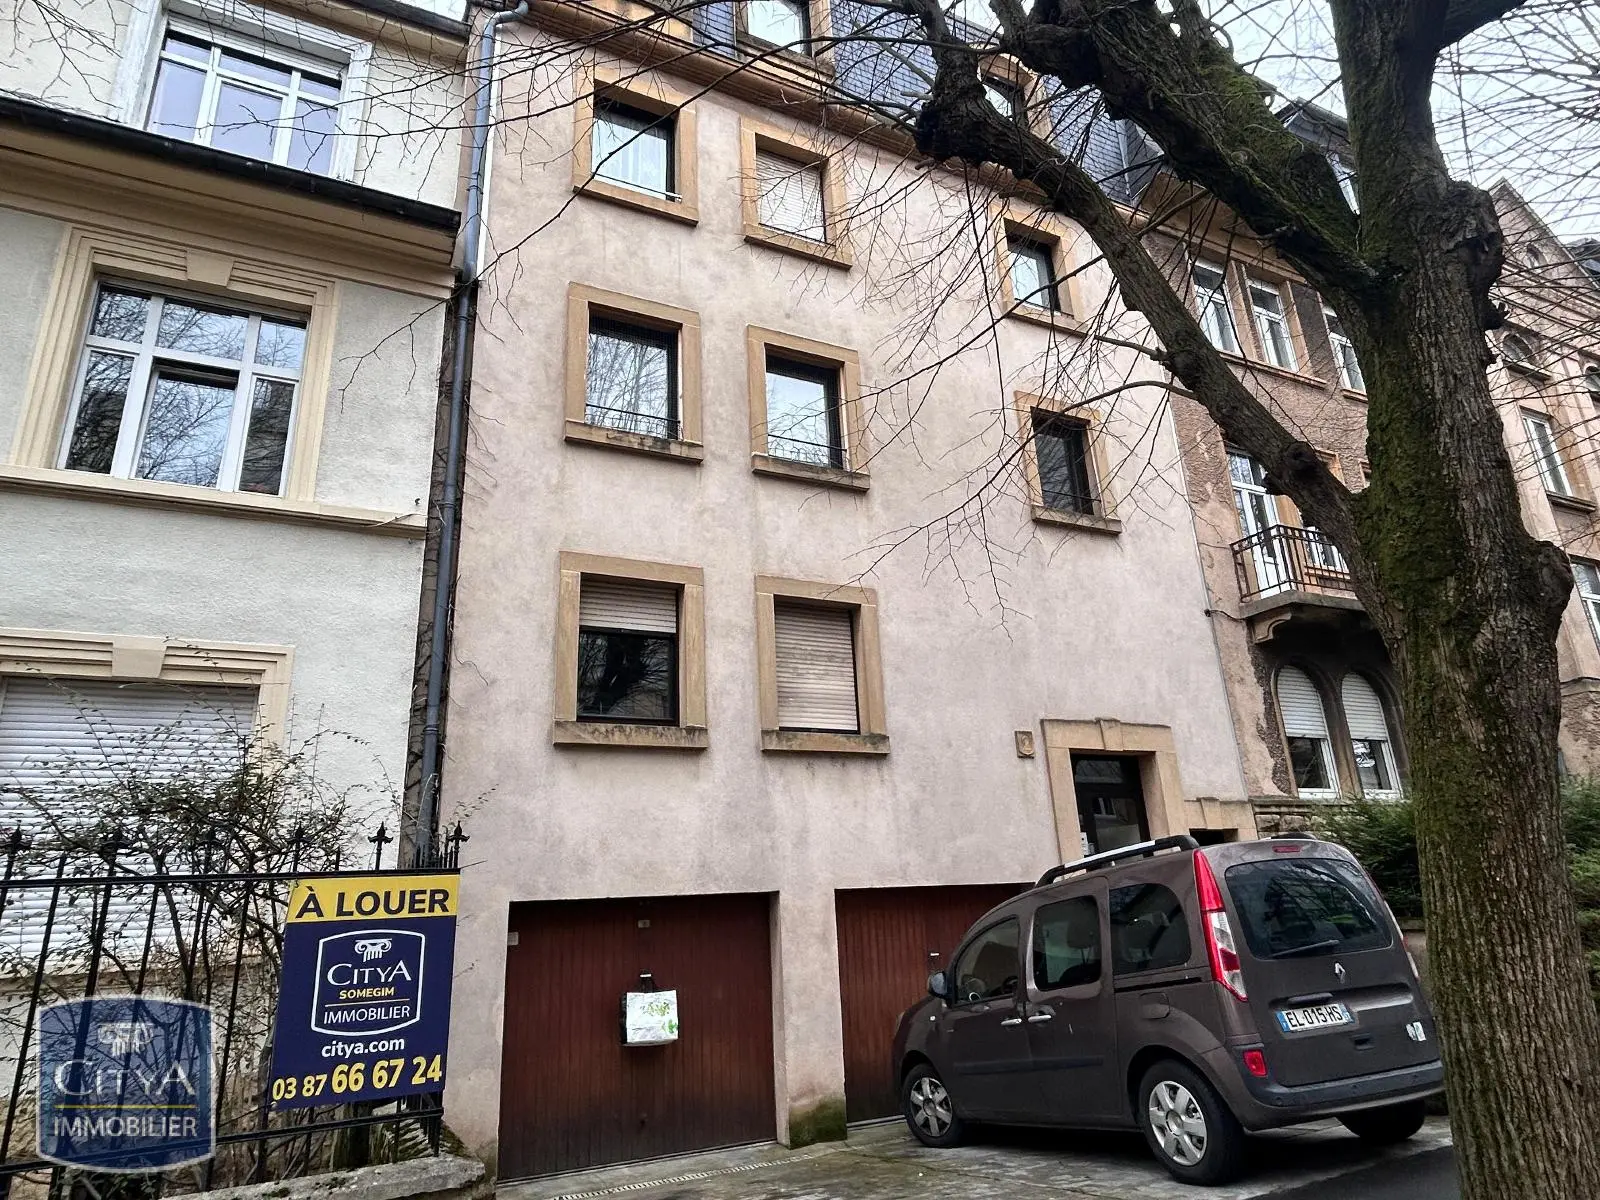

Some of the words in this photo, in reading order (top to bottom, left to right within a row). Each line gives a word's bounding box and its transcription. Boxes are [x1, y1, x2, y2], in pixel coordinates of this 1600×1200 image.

[295, 885, 325, 919] À
[335, 888, 450, 918] LOUER
[339, 986, 395, 1000] SOMEGIM
[323, 1005, 411, 1025] IMMOBILIER
[321, 1038, 405, 1059] citya.com
[272, 1077, 297, 1101] 03
[302, 1073, 327, 1098] 87
[331, 1062, 365, 1094] 66
[372, 1057, 405, 1089] 67
[411, 1054, 442, 1085] 24
